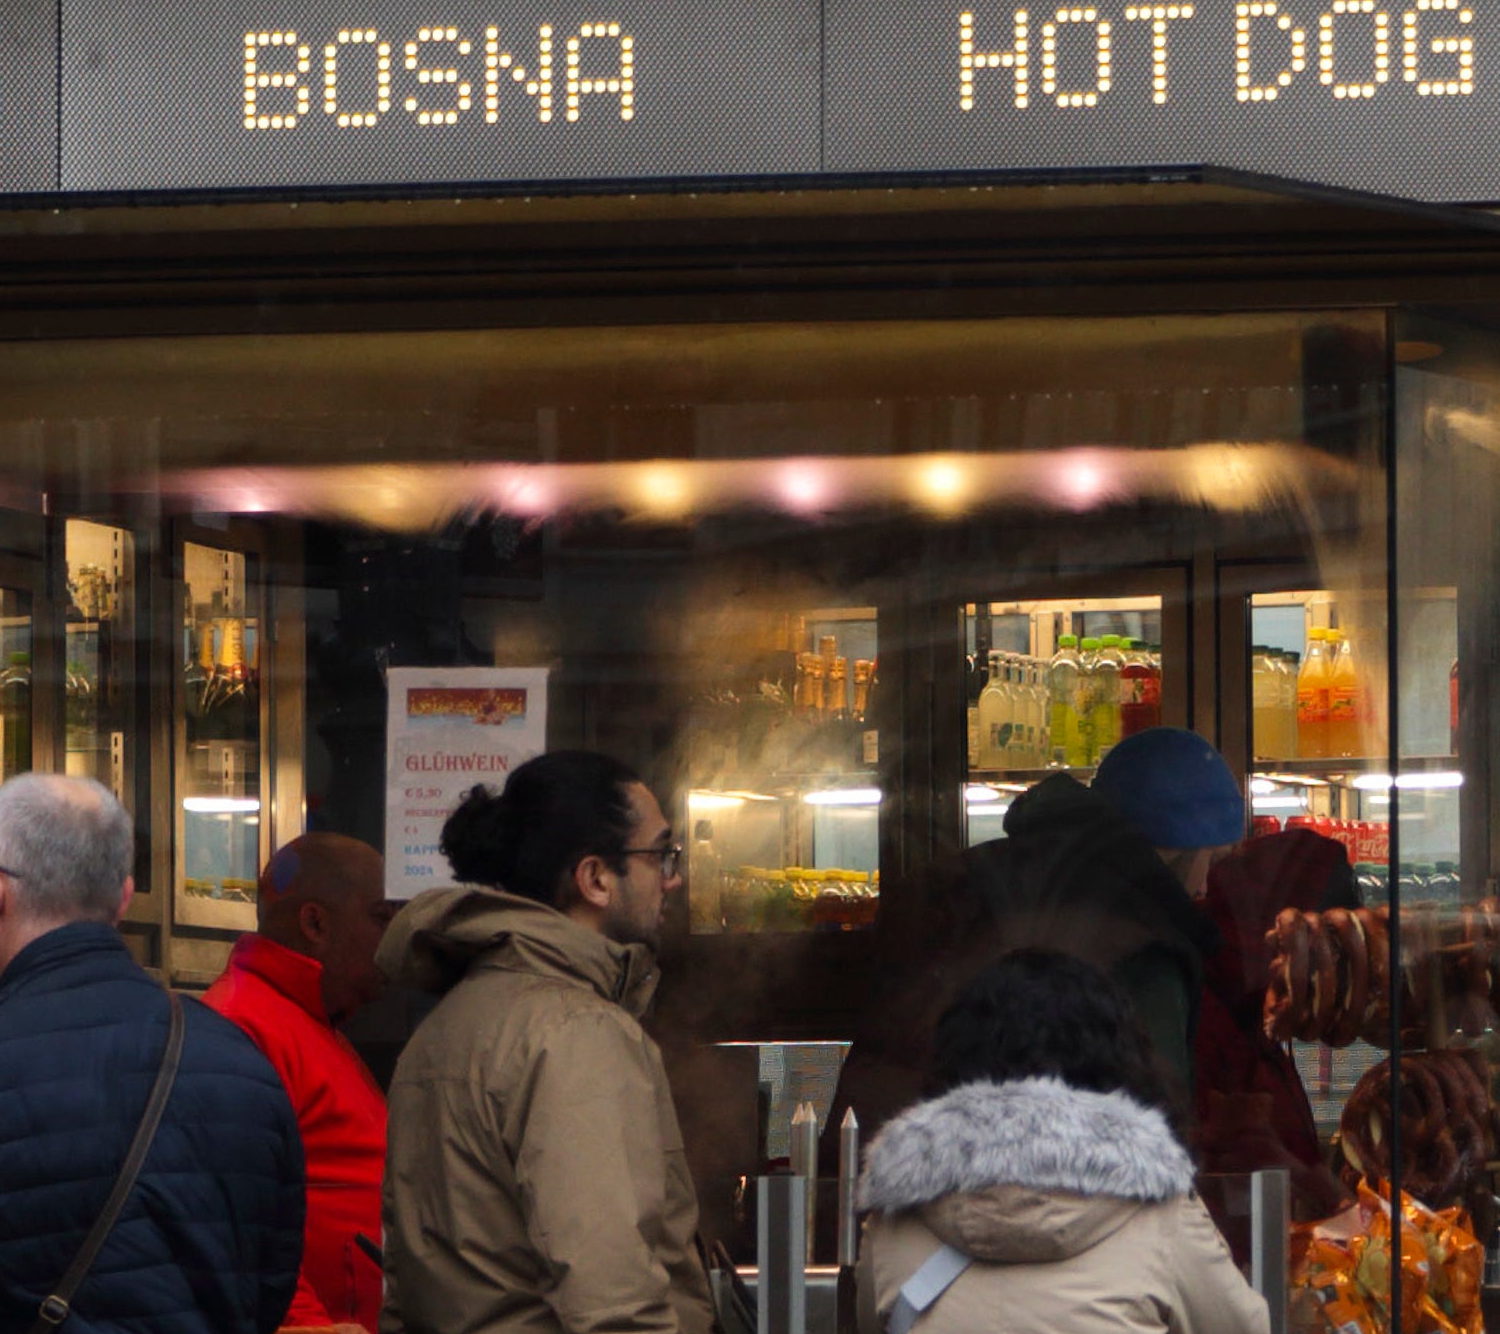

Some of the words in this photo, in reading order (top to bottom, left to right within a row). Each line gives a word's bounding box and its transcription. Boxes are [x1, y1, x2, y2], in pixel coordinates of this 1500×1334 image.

[244, 21, 636, 131] BOSNA
[959, 3, 1197, 113] HOT
[405, 751, 508, 772] GLÜHWEIN
